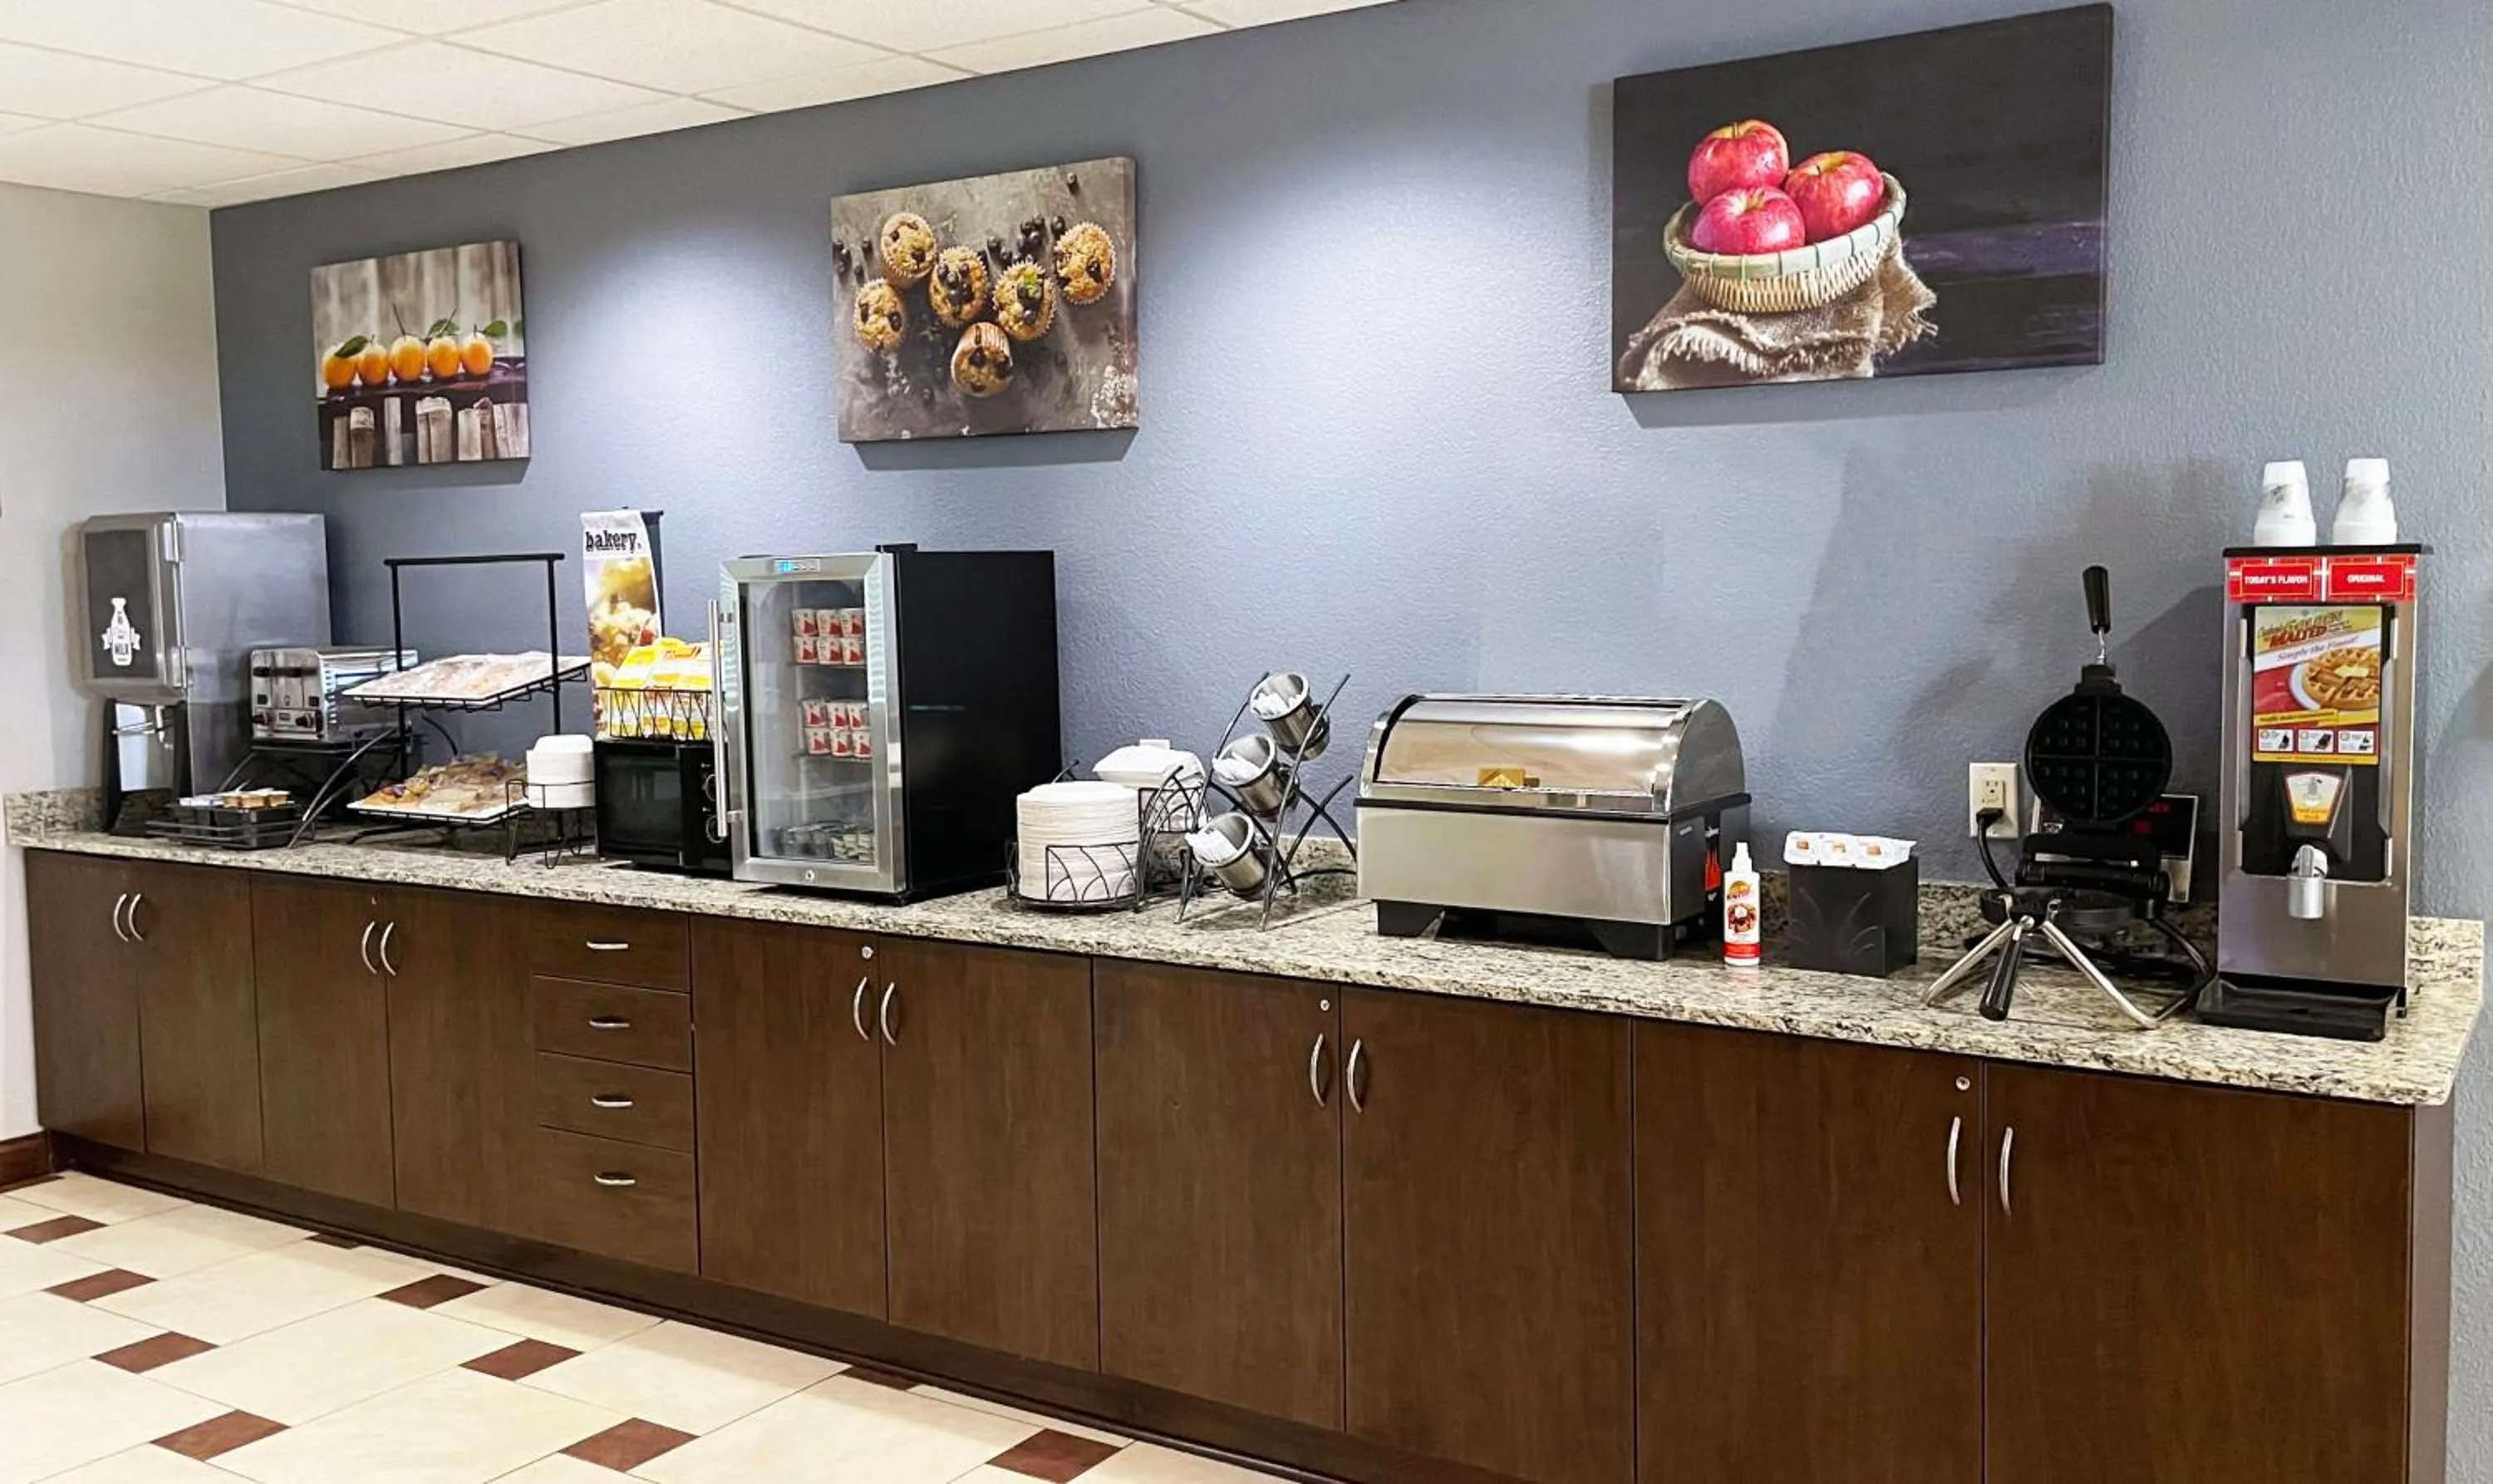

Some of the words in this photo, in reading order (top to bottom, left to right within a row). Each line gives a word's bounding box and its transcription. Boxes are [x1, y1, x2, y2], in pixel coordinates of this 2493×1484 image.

[585, 529, 642, 554] bakery.
[2278, 574, 2308, 584] FLAVOR
[2347, 573, 2384, 583] ORIGINAL
